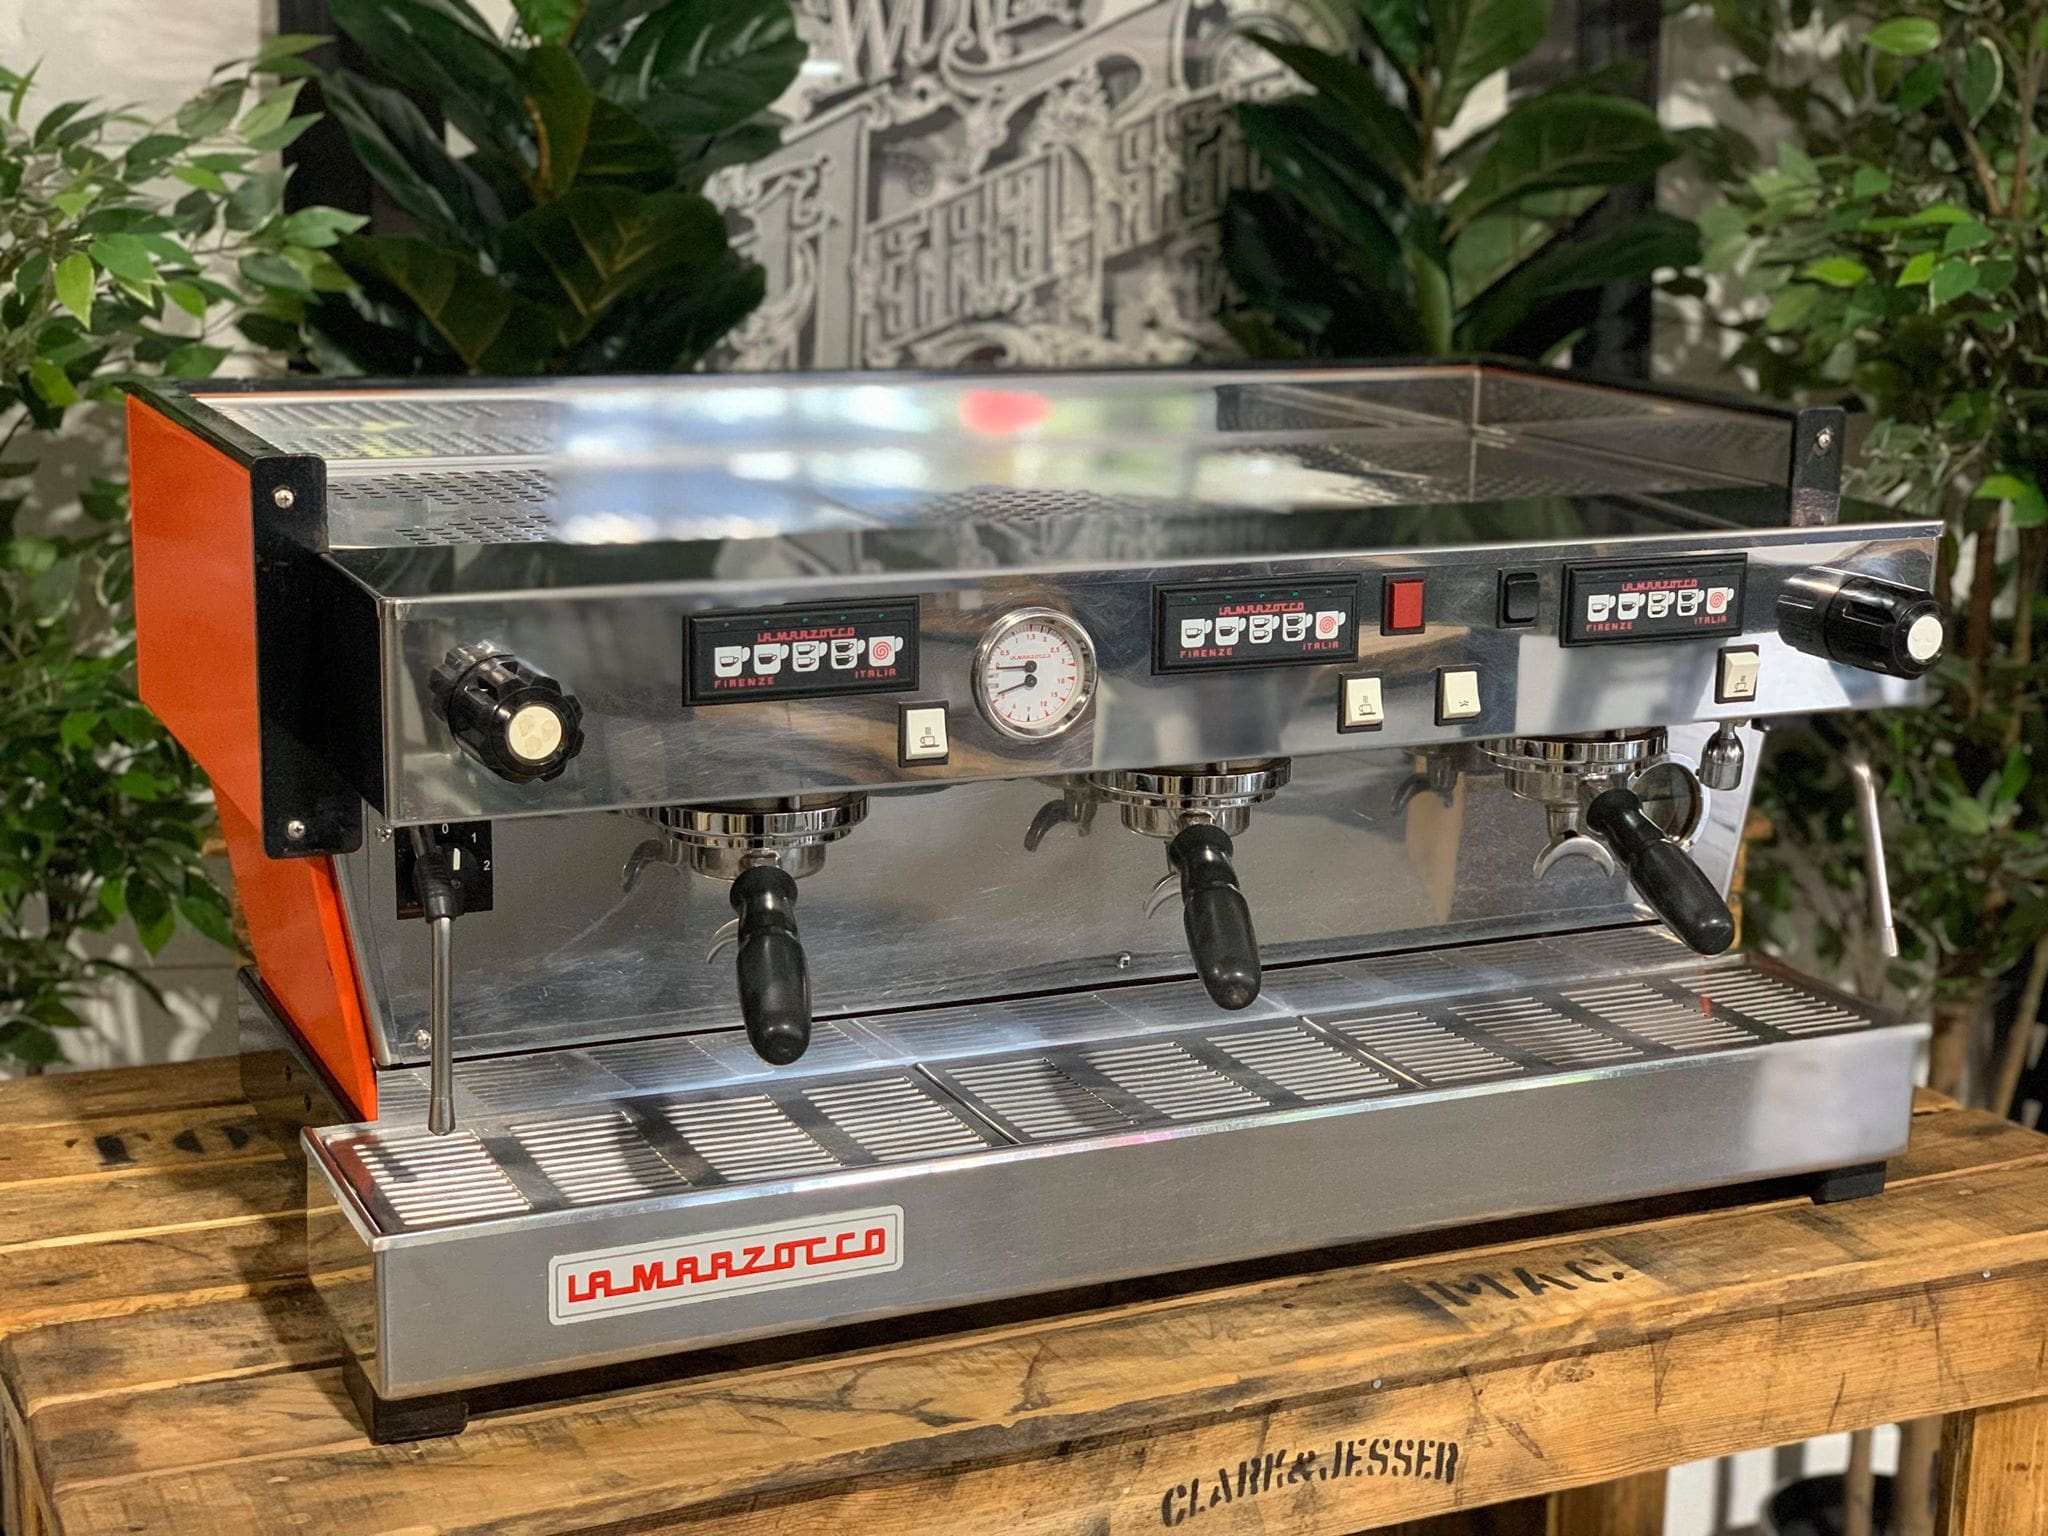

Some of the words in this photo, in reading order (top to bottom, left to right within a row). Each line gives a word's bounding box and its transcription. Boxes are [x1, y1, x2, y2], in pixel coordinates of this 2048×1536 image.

[1621, 583, 1632, 592] LA
[1637, 578, 1698, 591] MARZOCCO
[1219, 606, 1231, 616] LA
[1235, 602, 1305, 615] MARZOCCO
[1694, 615, 1728, 625] ITALIA
[1585, 622, 1634, 633] FIRENZE
[757, 632, 772, 643] LA
[777, 627, 855, 641] MARZOCCO
[1302, 640, 1339, 651] ITALIA
[1180, 647, 1233, 659] FIRENZE
[855, 668, 897, 679] ITALIA
[714, 677, 775, 689] FIRENZE
[441, 823, 449, 834] 0
[471, 832, 477, 843] 1
[483, 860, 491, 871] 2
[568, 1269, 612, 1304] LA
[633, 1227, 886, 1291] MARZOCCO
